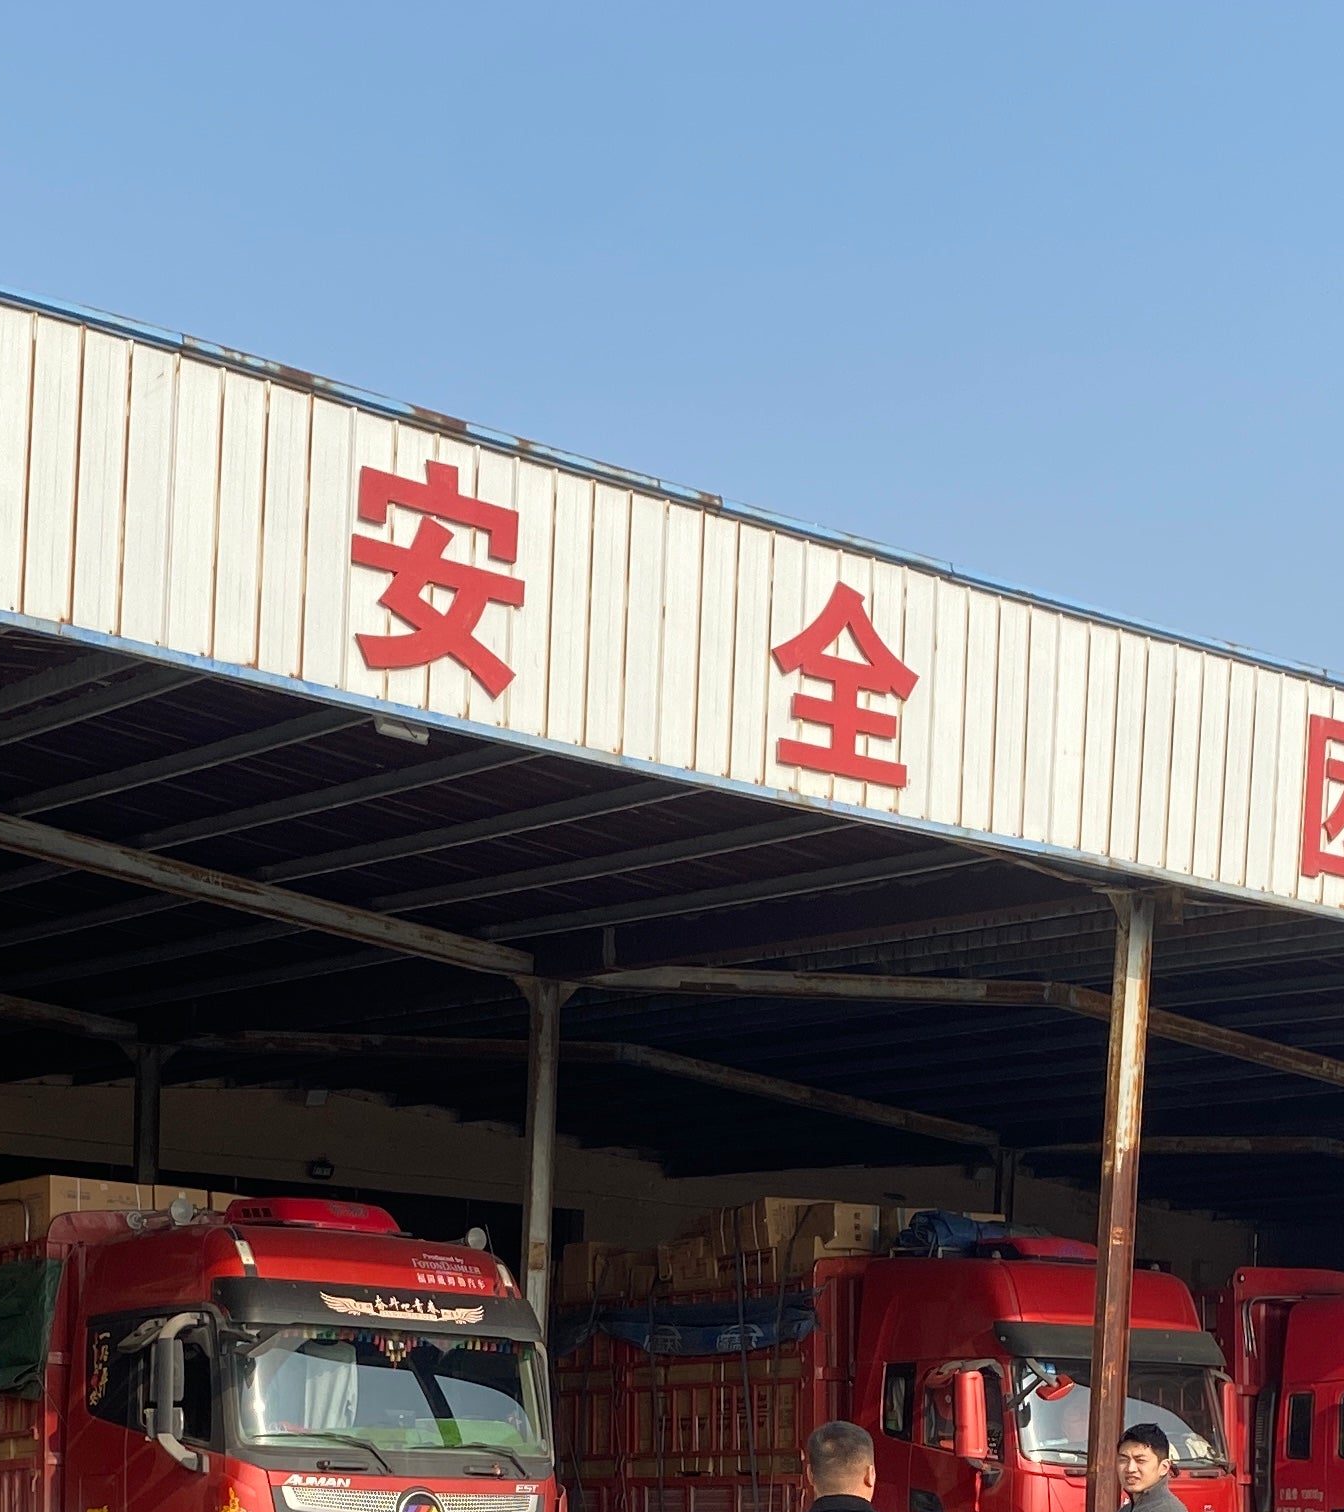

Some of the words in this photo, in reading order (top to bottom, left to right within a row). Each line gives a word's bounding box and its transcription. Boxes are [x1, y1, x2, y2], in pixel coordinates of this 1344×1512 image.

[347, 461, 917, 810] 安全
[422, 1253, 454, 1263] Produced
[454, 1256, 464, 1265] by
[282, 1474, 351, 1488] AUMAN
[515, 1484, 539, 1493] EST
